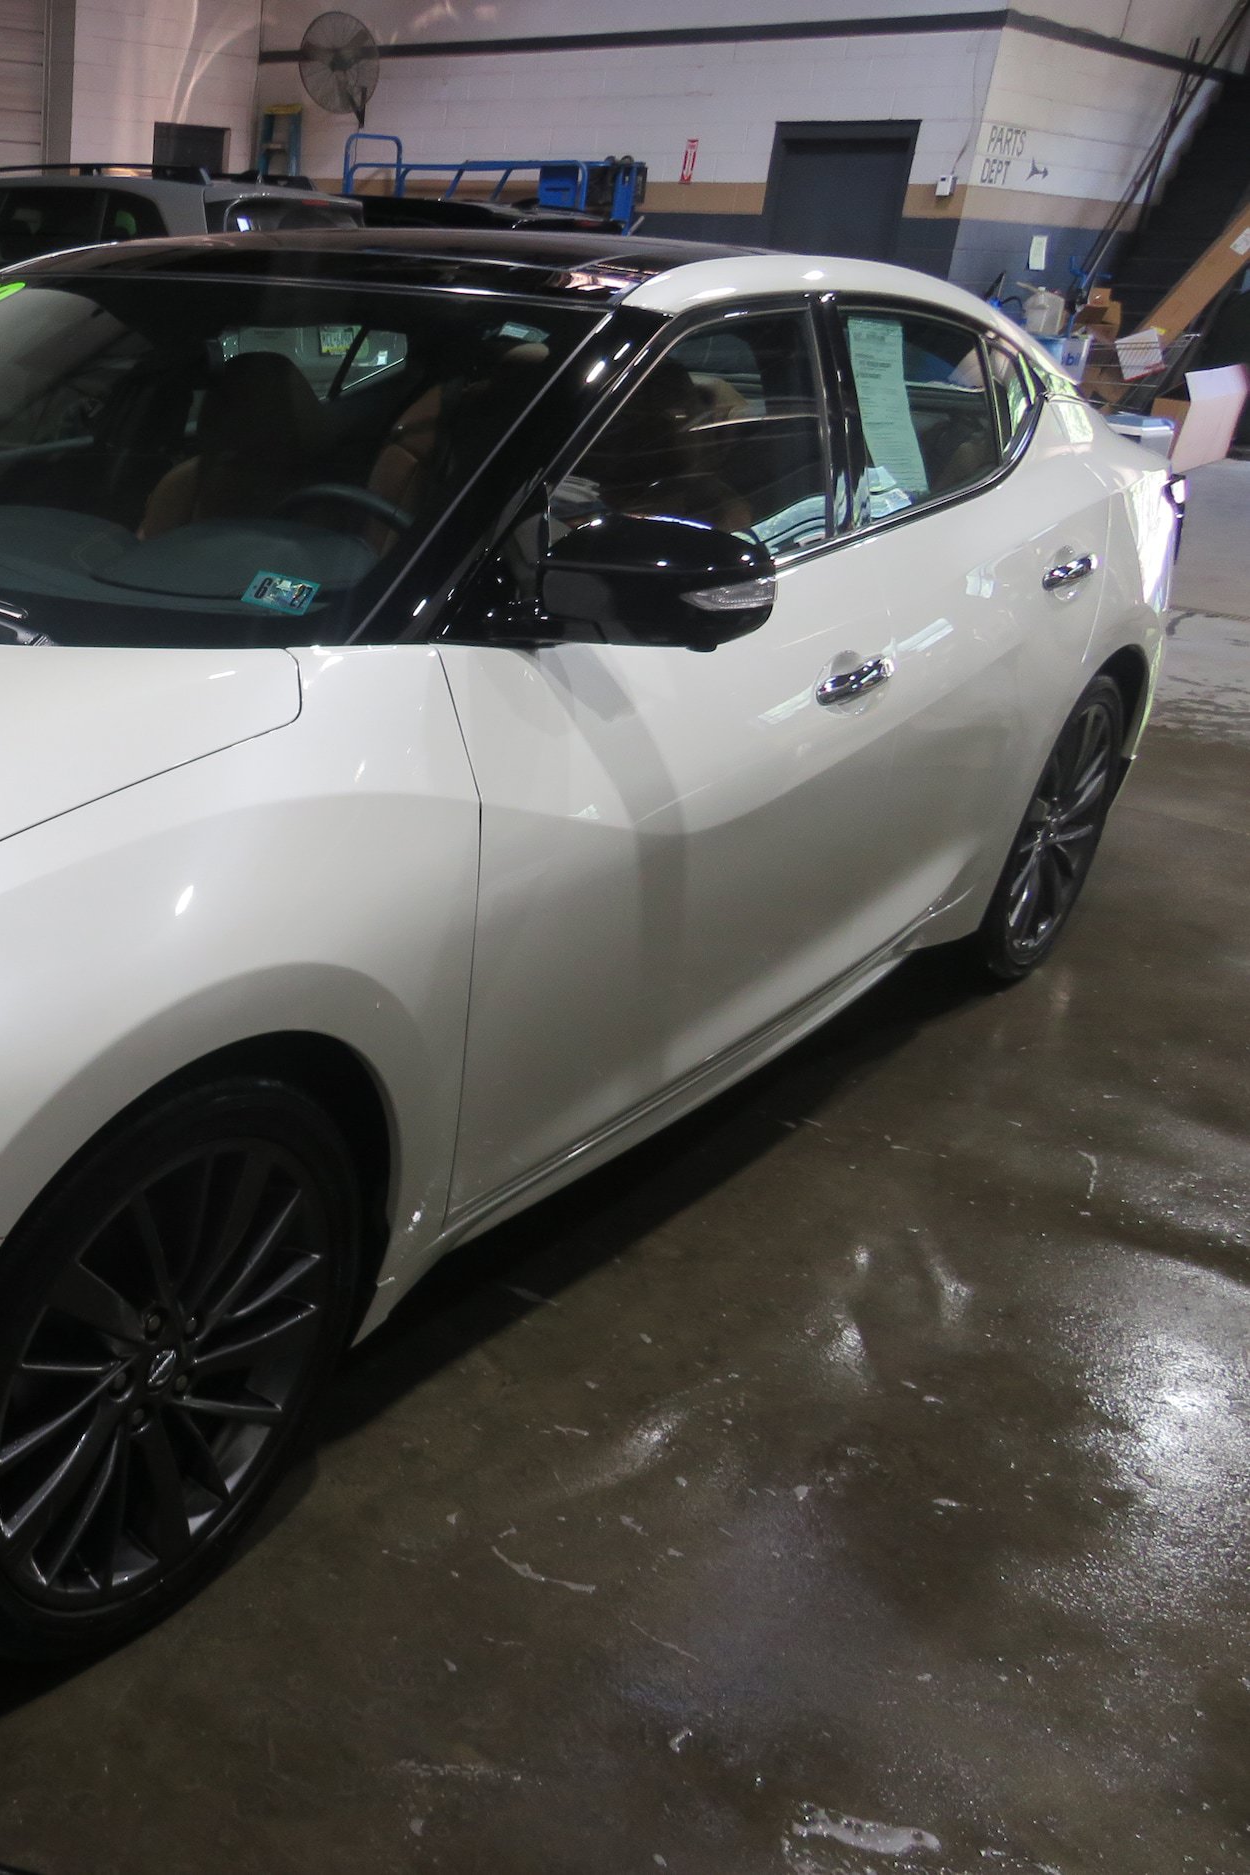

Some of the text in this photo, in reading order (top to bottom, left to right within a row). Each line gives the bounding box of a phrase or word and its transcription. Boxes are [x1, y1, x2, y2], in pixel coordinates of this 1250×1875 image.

[986, 125, 1027, 157] PARTS
[980, 158, 1011, 185] DEPT
[253, 577, 273, 599] 6
